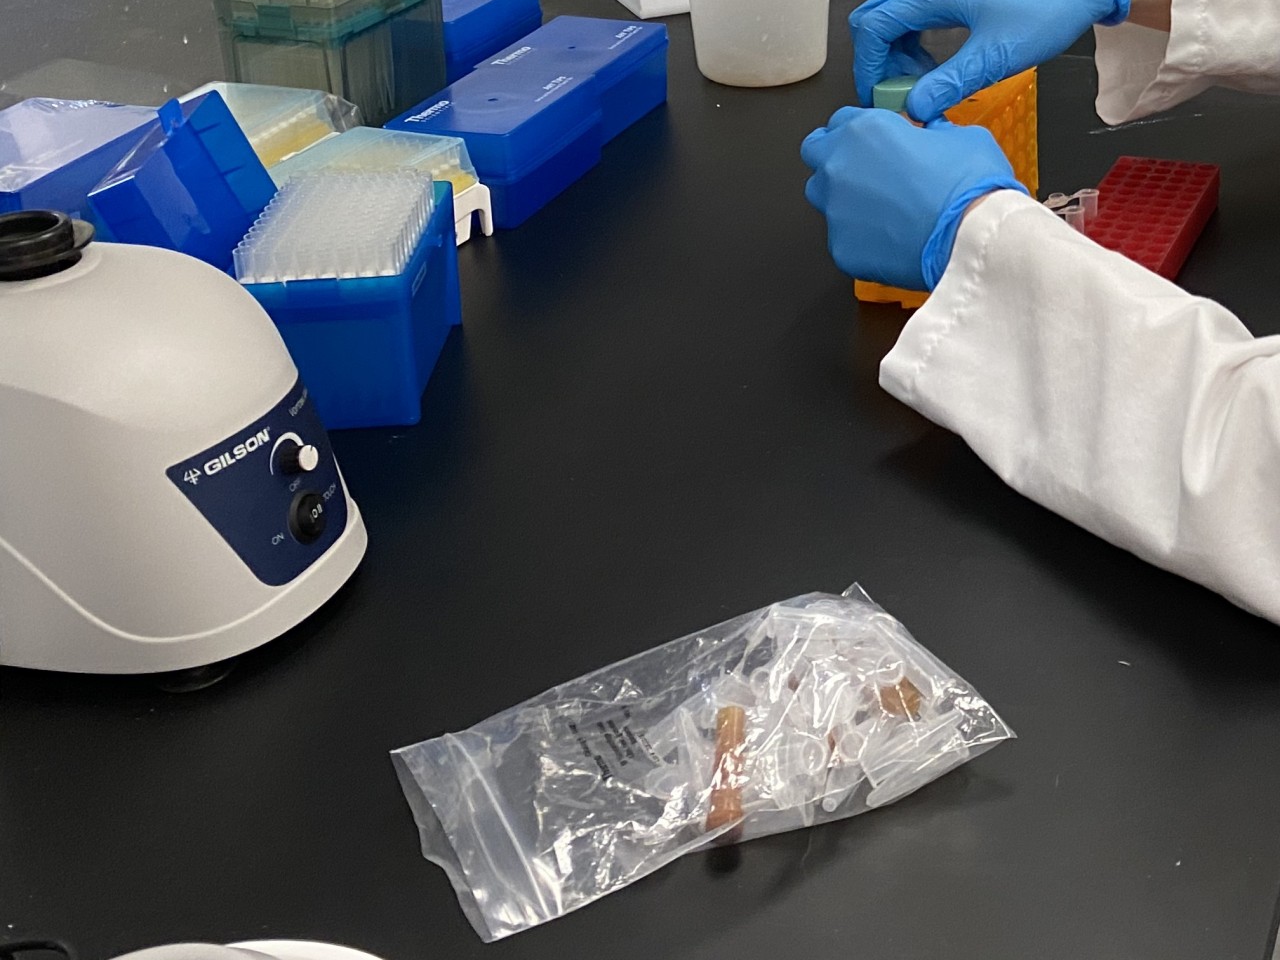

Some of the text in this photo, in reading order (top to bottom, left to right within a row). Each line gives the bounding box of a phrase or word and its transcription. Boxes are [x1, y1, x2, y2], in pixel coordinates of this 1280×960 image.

[490, 46, 532, 65] Thermo
[404, 100, 451, 123] Thermo
[271, 532, 285, 546] ON
